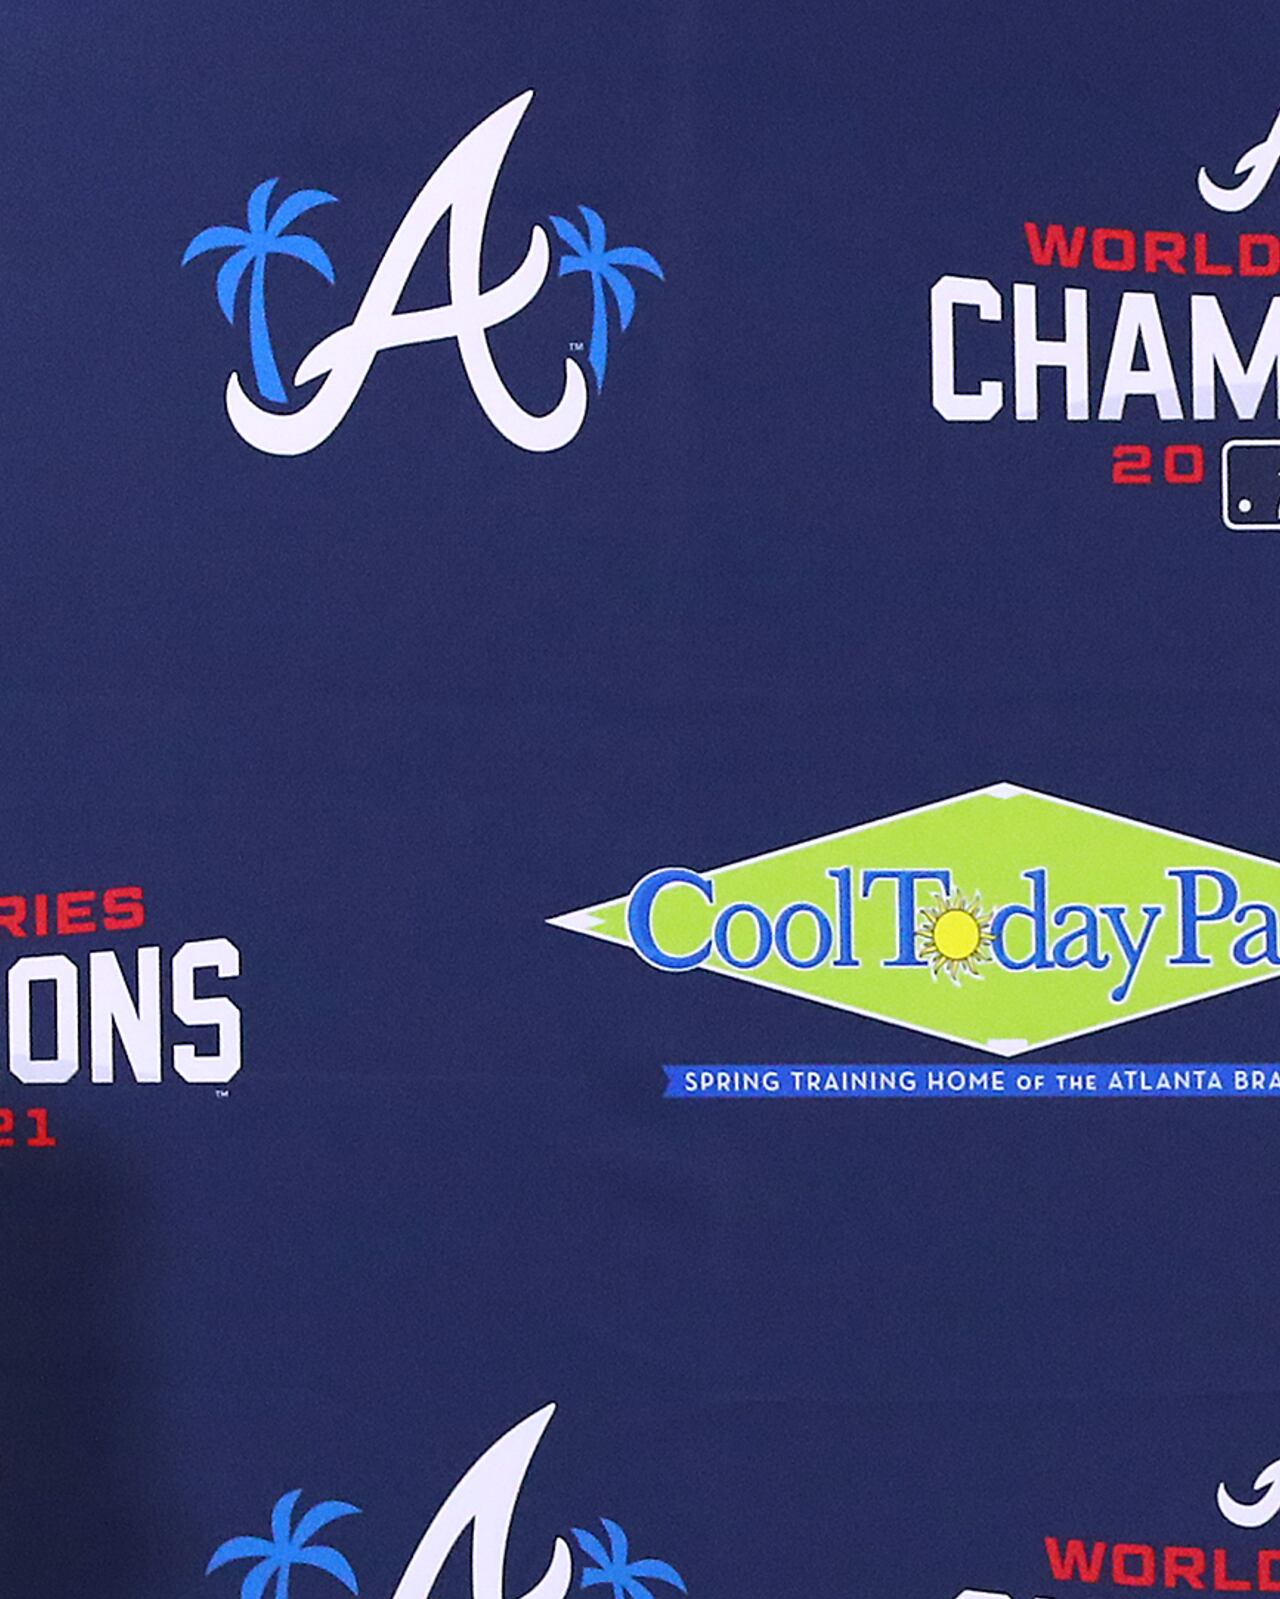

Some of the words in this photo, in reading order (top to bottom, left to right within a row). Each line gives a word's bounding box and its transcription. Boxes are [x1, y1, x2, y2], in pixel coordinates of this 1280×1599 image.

[226, 89, 587, 456] A
[1112, 444, 1205, 485] 20
[685, 1071, 780, 1092] SPRING
[790, 1071, 916, 1092] TRAINING
[928, 1070, 1005, 1091] HOME
[1016, 1075, 1044, 1091] OF
[1055, 1074, 1097, 1091] THE
[1108, 1070, 1222, 1091] ATLANTA
